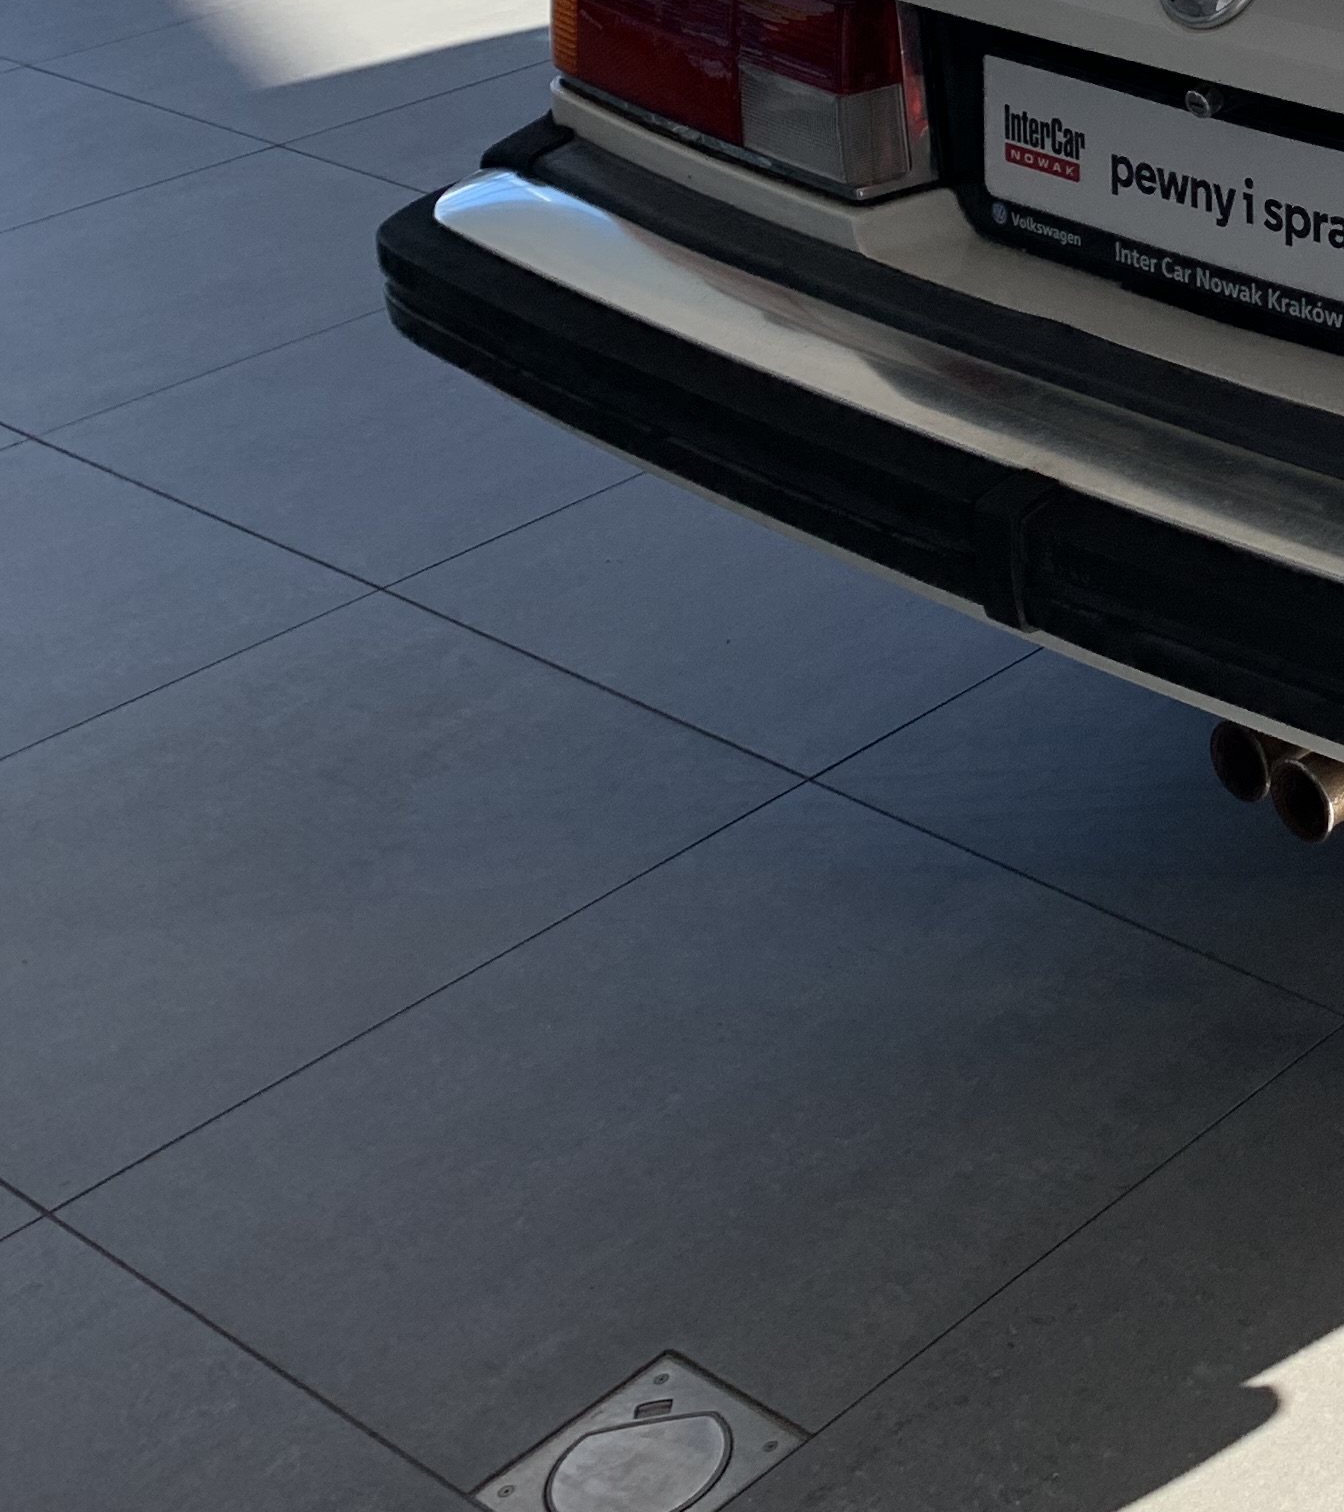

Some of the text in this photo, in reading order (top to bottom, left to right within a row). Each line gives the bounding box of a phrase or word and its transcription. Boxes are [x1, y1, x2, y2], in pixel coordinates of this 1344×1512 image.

[1004, 104, 1085, 160] InterCar
[1010, 148, 1075, 178] NOWAK
[1111, 153, 1236, 227] pewny
[1243, 177, 1255, 225] i
[1011, 211, 1081, 248] Volkswagen
[1115, 241, 1344, 329] Inter Car Nowak Kraków
